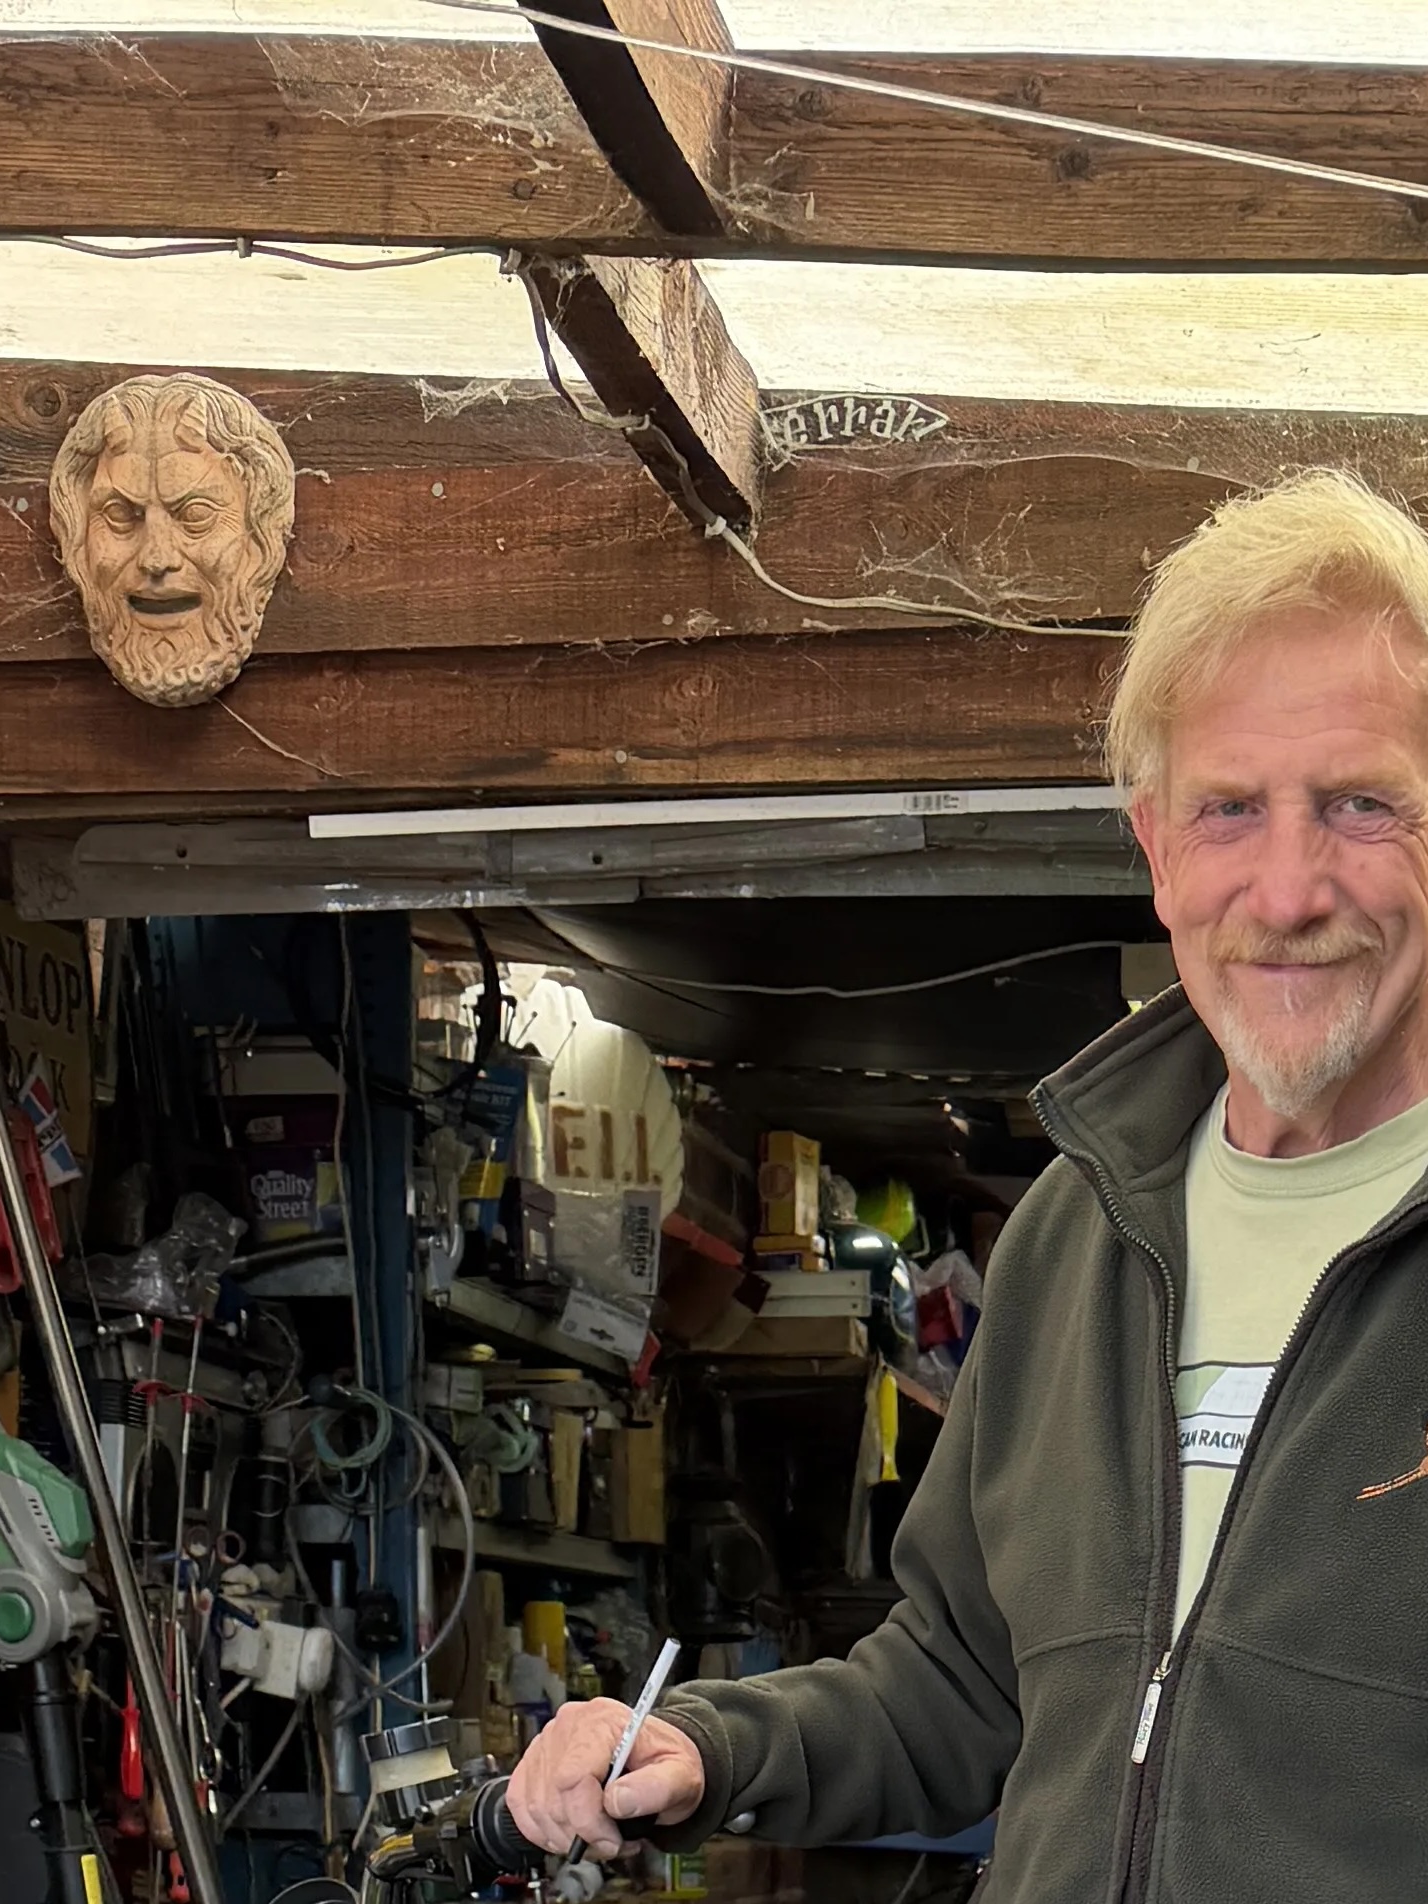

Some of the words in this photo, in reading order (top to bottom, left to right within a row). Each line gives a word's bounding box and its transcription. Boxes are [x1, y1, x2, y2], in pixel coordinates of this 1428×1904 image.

[251, 1174, 314, 1199] Quality
[256, 1200, 309, 1219] Street
[1198, 1429, 1247, 1450] RACIN
